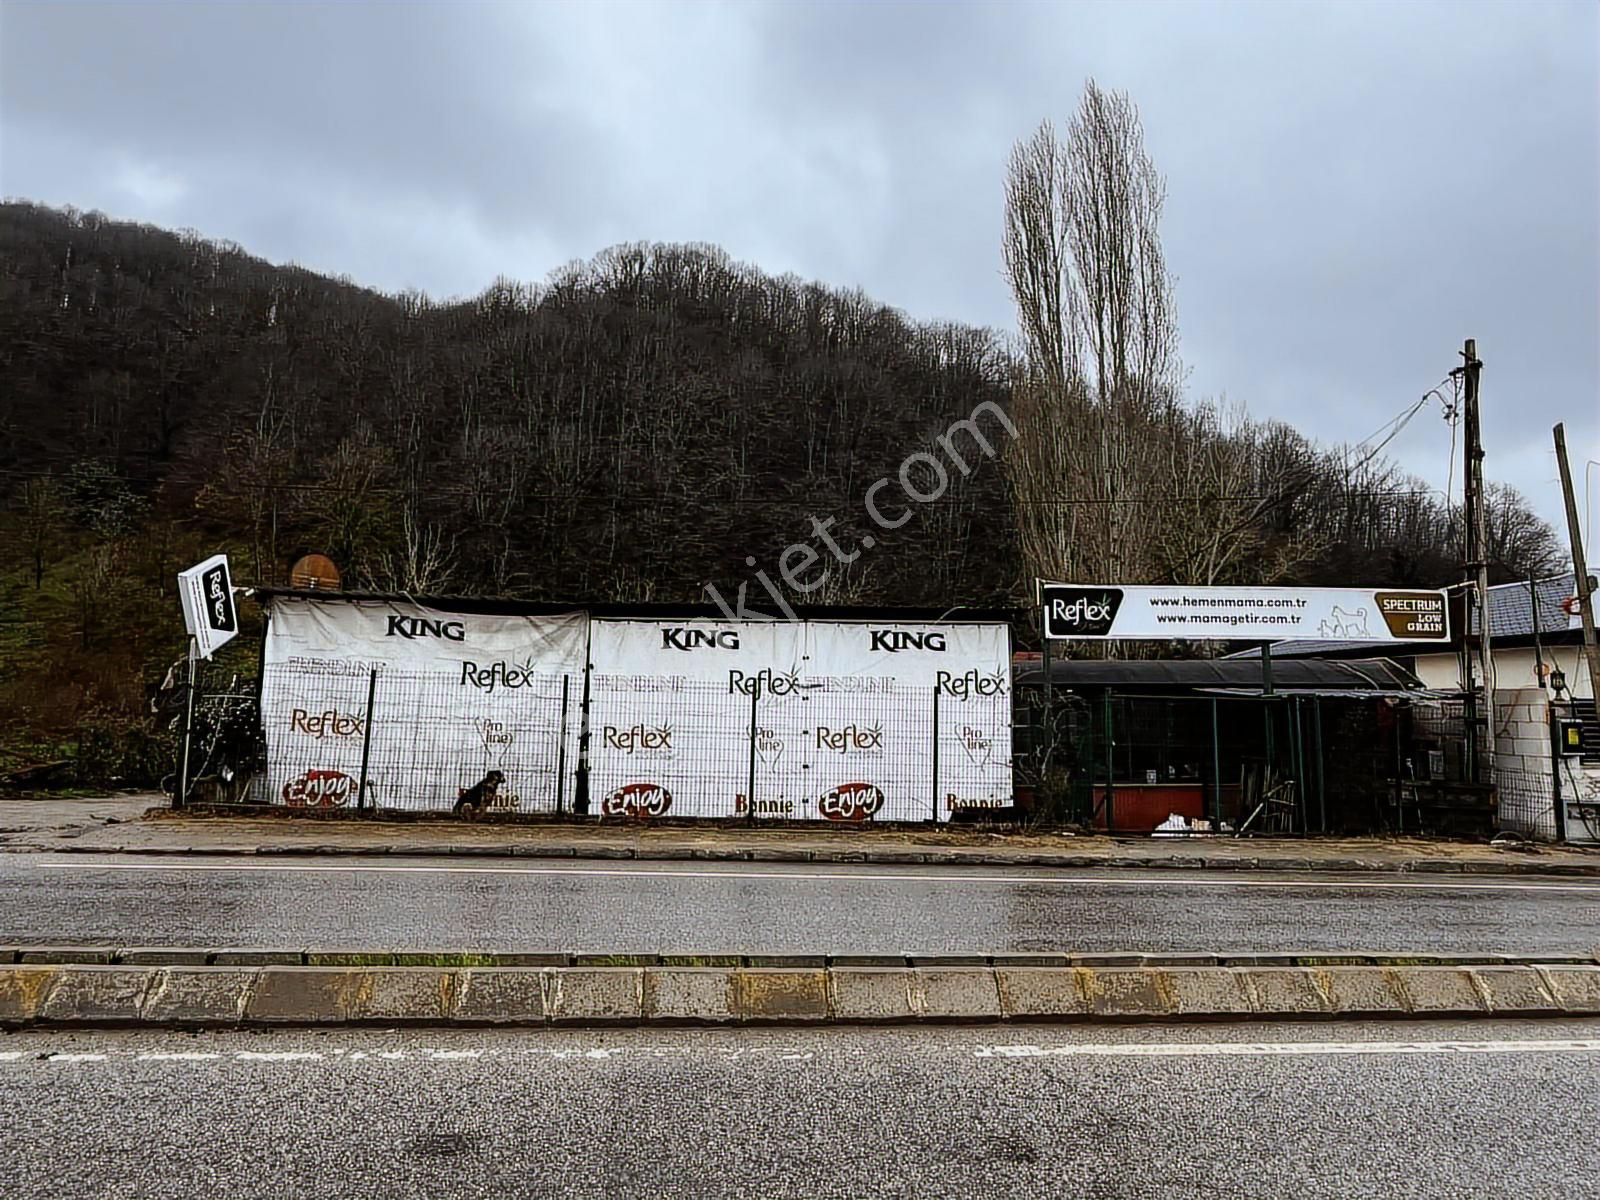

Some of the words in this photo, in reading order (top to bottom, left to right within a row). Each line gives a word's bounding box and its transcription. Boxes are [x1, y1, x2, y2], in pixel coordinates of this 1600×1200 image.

[209, 570, 226, 627] Reflex
[1149, 596, 1308, 608] www.hemenmama.com.tr
[1383, 598, 1442, 611] SPECTRUM
[1052, 597, 1111, 626] Reflex
[1156, 613, 1302, 626] www.mamagetir.com.tr
[1418, 613, 1443, 623] LOW
[385, 615, 465, 642] KING
[661, 627, 740, 652] KING
[1406, 622, 1443, 632] GRAIN
[870, 629, 946, 653] KING
[460, 660, 534, 694] Reflex
[729, 667, 799, 701] Reflex
[936, 668, 1006, 702] Reflex
[290, 708, 365, 740] Reflex
[755, 726, 774, 738] Pro
[963, 726, 983, 739] Pro
[485, 730, 509, 744] line
[603, 723, 672, 754] Reflex
[759, 737, 781, 751] line
[816, 723, 883, 754] Reflex
[967, 737, 989, 750] line
[288, 774, 351, 806] Enjoy
[606, 788, 665, 816] Enjoy
[735, 792, 793, 813] Bnnie
[821, 786, 878, 817] Enjoy
